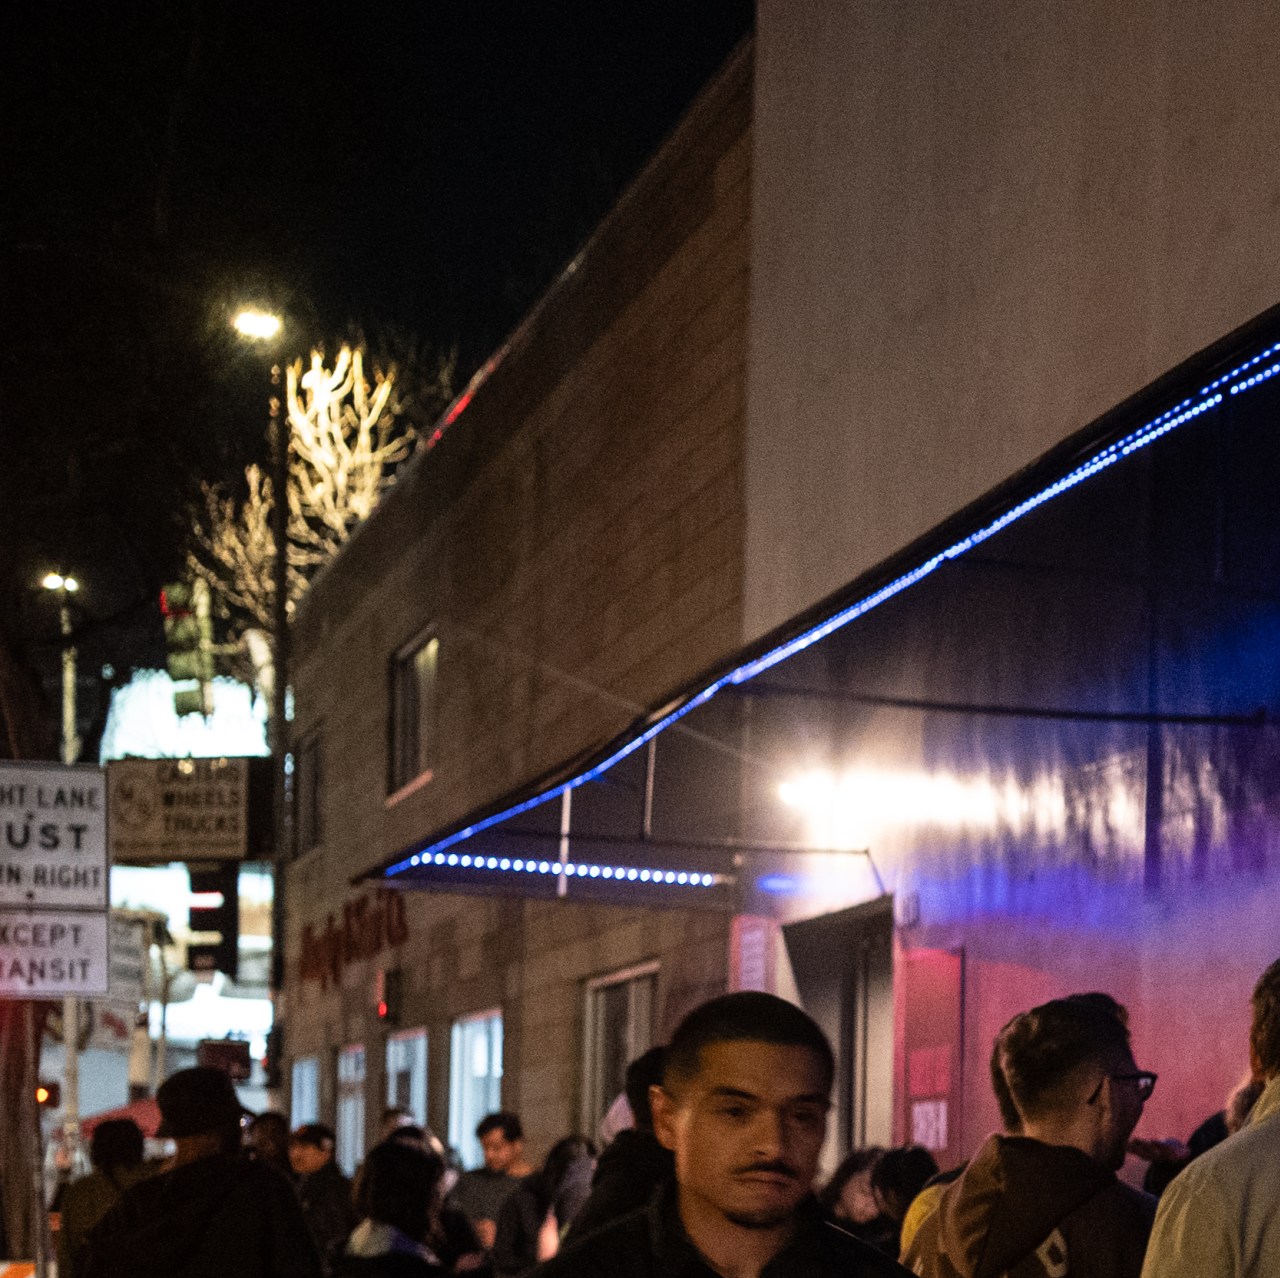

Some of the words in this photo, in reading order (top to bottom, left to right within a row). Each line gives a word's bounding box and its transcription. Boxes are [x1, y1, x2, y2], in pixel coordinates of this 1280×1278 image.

[37, 785, 101, 811] LANE
[33, 864, 100, 888] RIGHT
[0, 957, 90, 984] ANSIT
